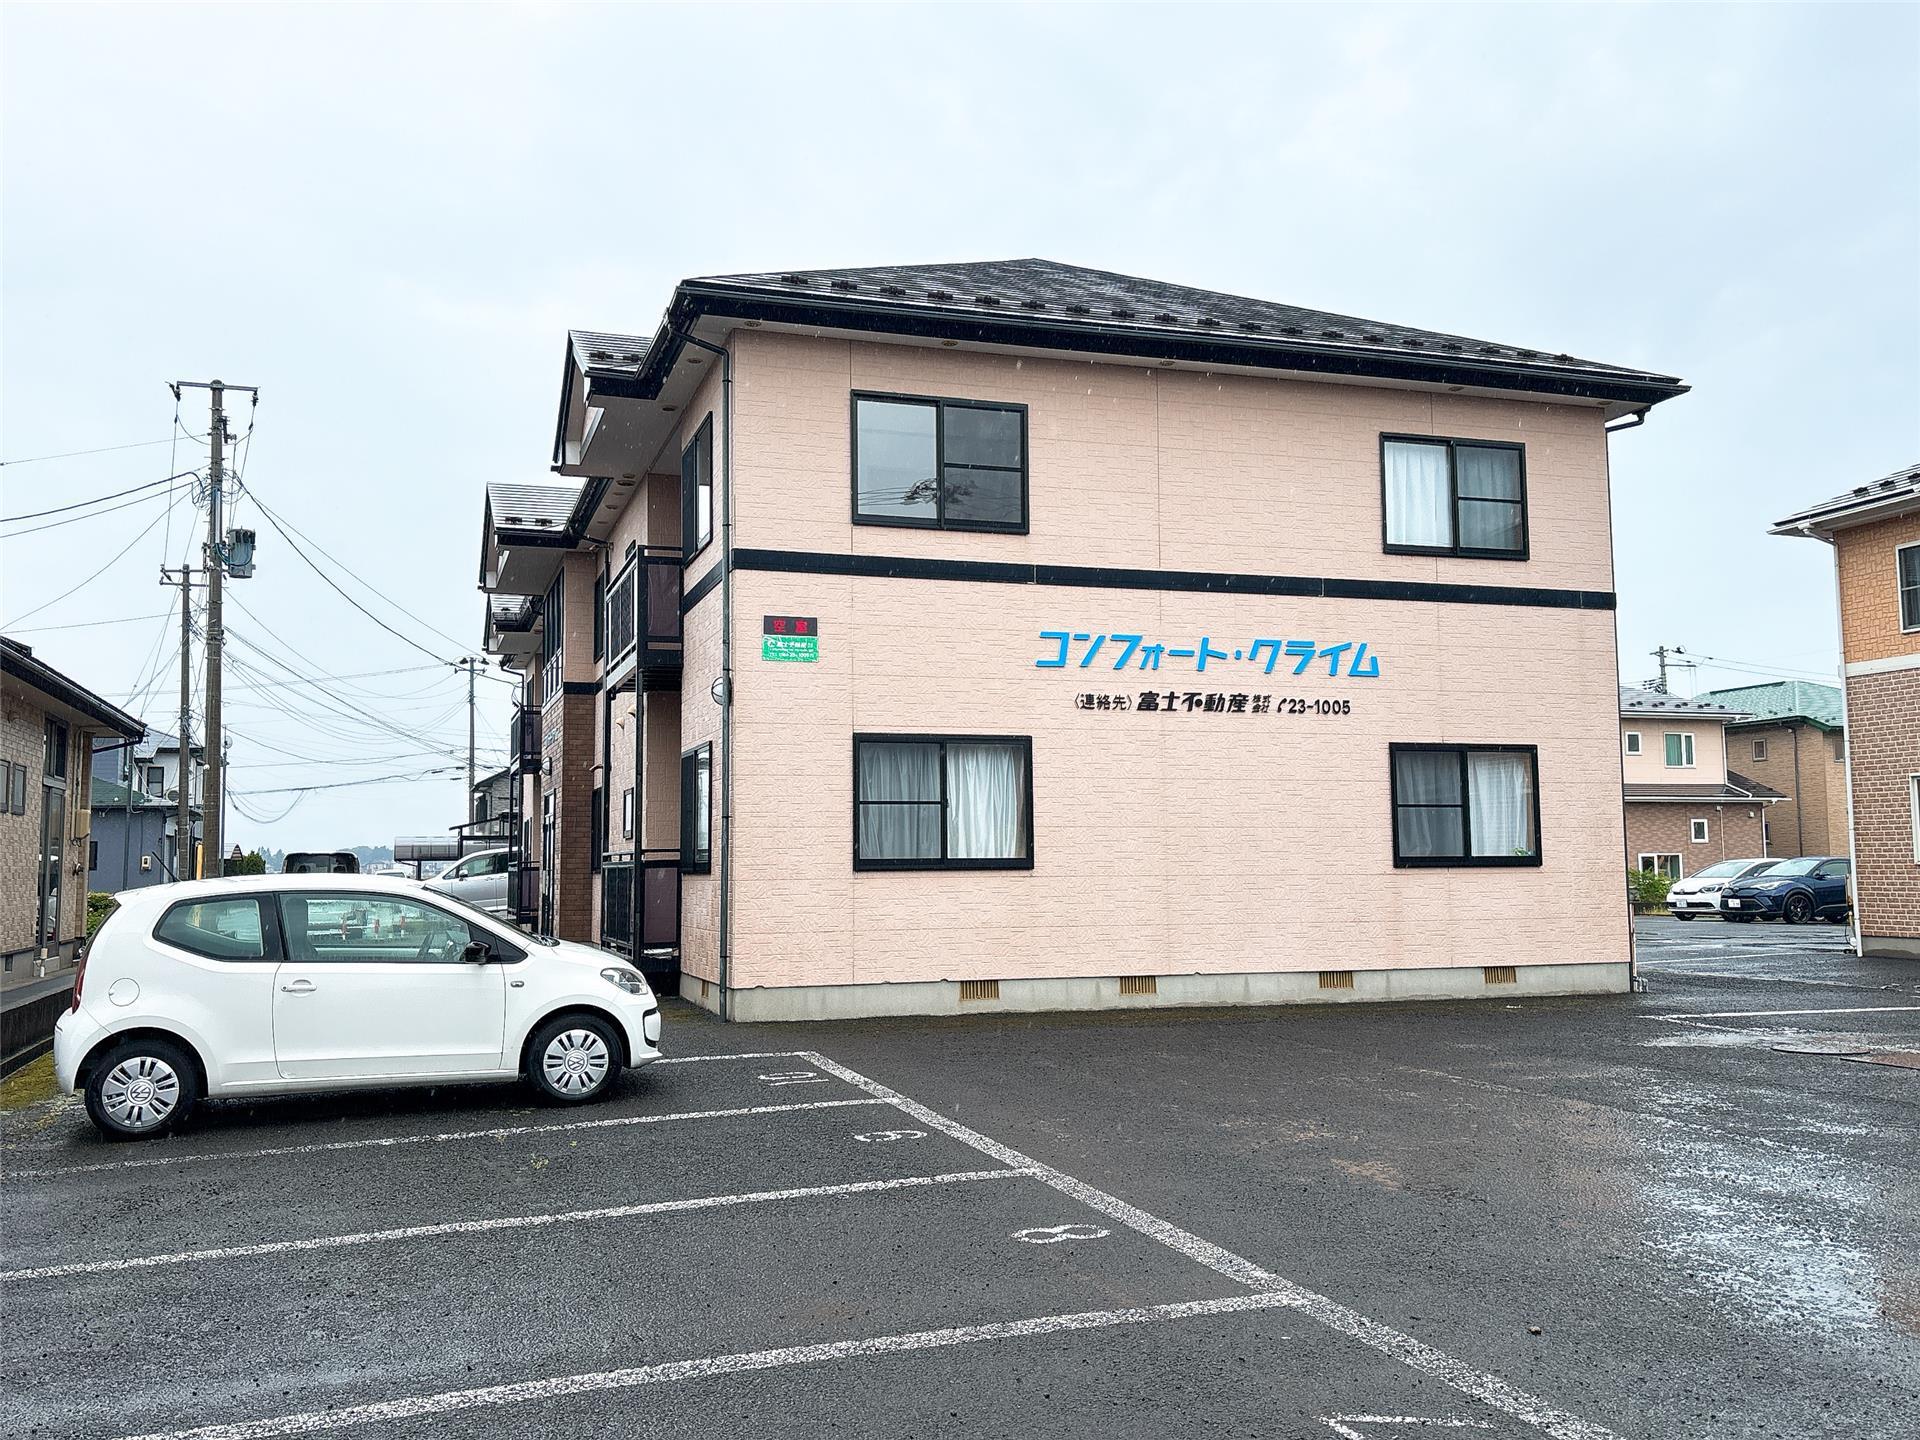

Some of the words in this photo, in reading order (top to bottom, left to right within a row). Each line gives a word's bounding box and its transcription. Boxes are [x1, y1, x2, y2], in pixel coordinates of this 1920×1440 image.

[1035, 631, 1380, 677] コンフォート・クライム
[1136, 690, 1249, 713] 富士不動産
[1287, 698, 1351, 715] 23-1005
[1010, 1223, 1111, 1244] 8
